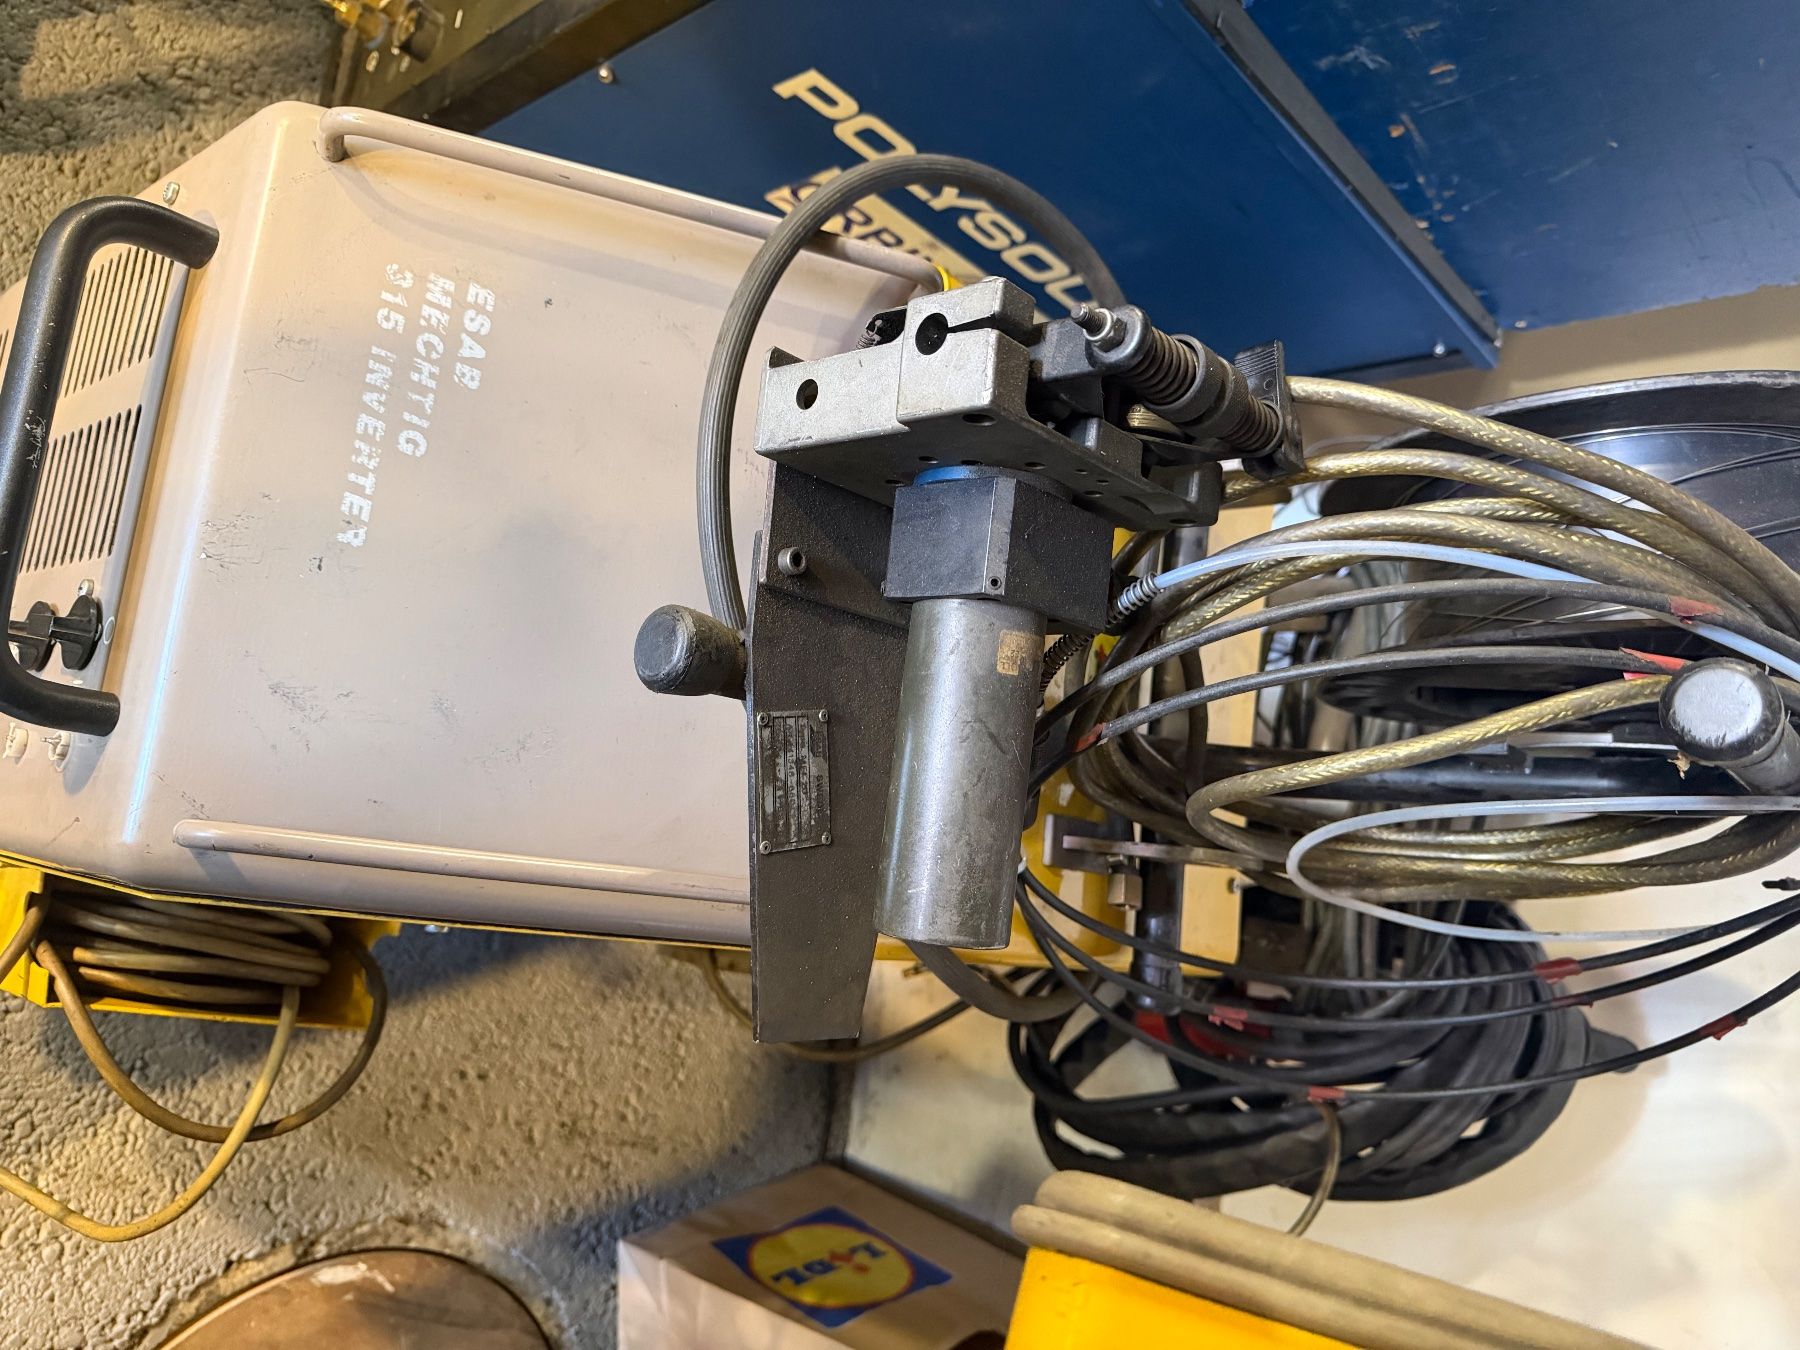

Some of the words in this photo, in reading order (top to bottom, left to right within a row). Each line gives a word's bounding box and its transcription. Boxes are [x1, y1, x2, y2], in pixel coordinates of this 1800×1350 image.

[375, 262, 415, 334] 315
[396, 272, 456, 458] MECHTIG
[452, 281, 496, 390] ESAB
[336, 345, 397, 548] INVERTER
